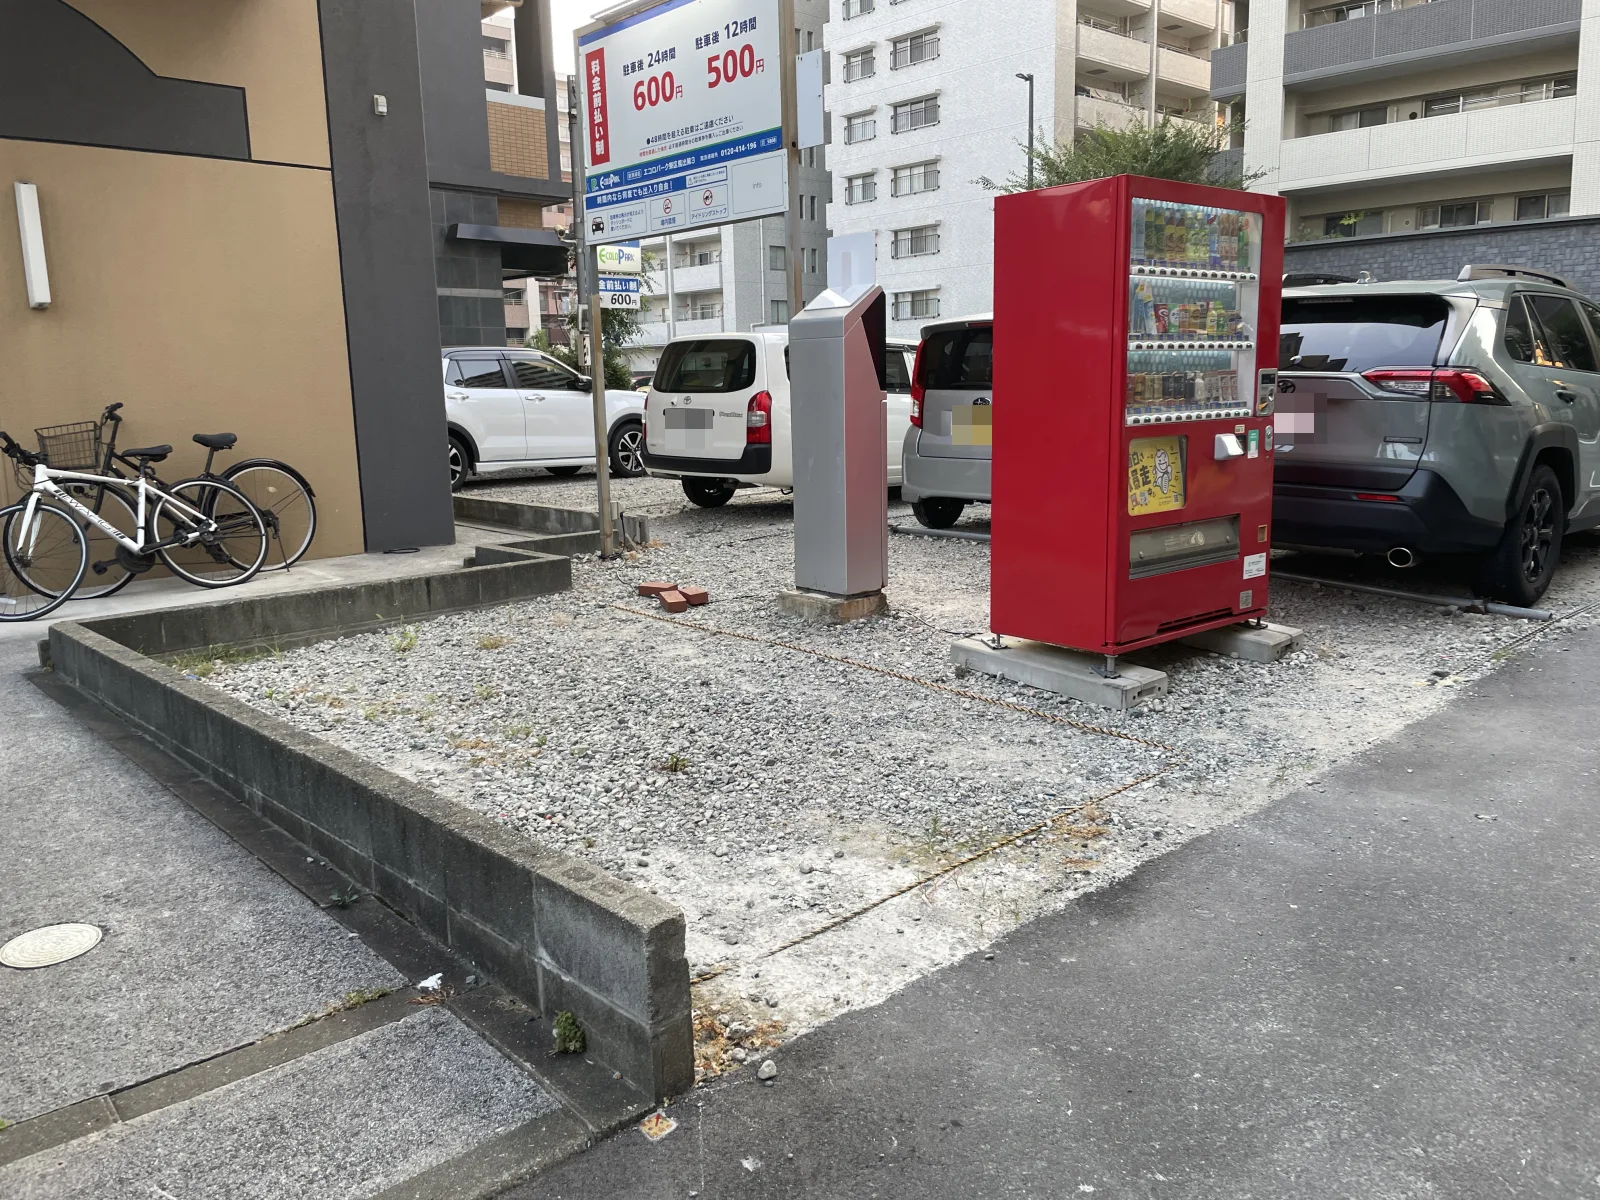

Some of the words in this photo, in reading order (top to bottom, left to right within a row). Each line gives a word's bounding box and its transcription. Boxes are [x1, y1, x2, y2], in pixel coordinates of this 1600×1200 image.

[695, 32, 720, 50] 駐車後
[724, 17, 757, 40] 12時間
[623, 59, 645, 77] 駐車後
[647, 47, 676, 68] 24時間
[707, 43, 765, 89] 500円
[633, 71, 683, 111] 600円
[691, 207, 727, 219] アイドリングストップ
